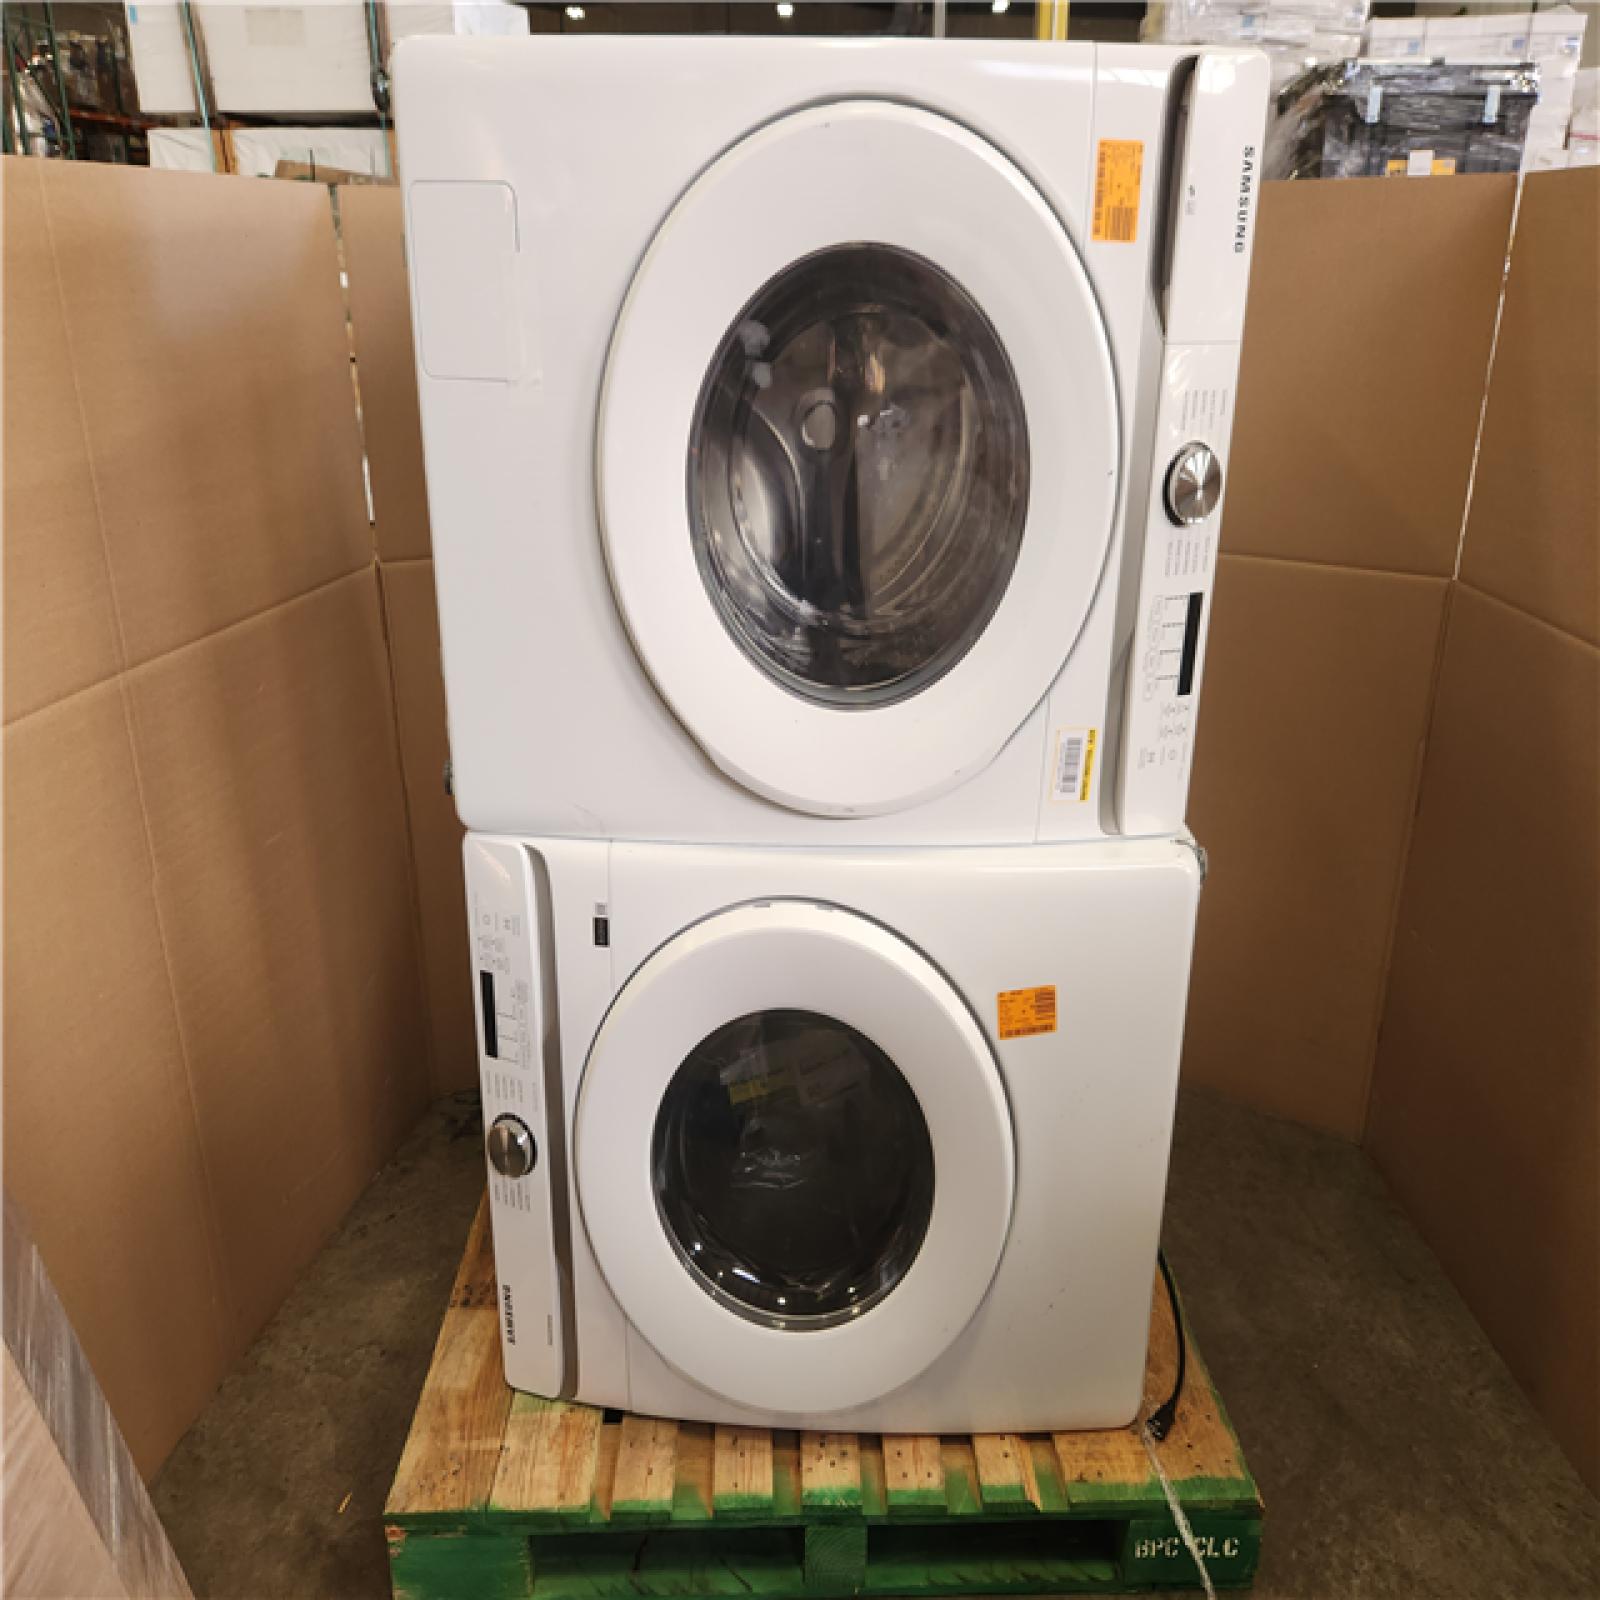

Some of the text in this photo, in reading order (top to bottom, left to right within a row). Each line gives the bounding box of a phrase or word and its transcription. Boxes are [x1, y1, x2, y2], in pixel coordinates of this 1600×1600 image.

[1234, 145, 1256, 253] SAMSUNG
[502, 1284, 516, 1345] SAMSUNG
[1192, 1536, 1240, 1558] CLC
